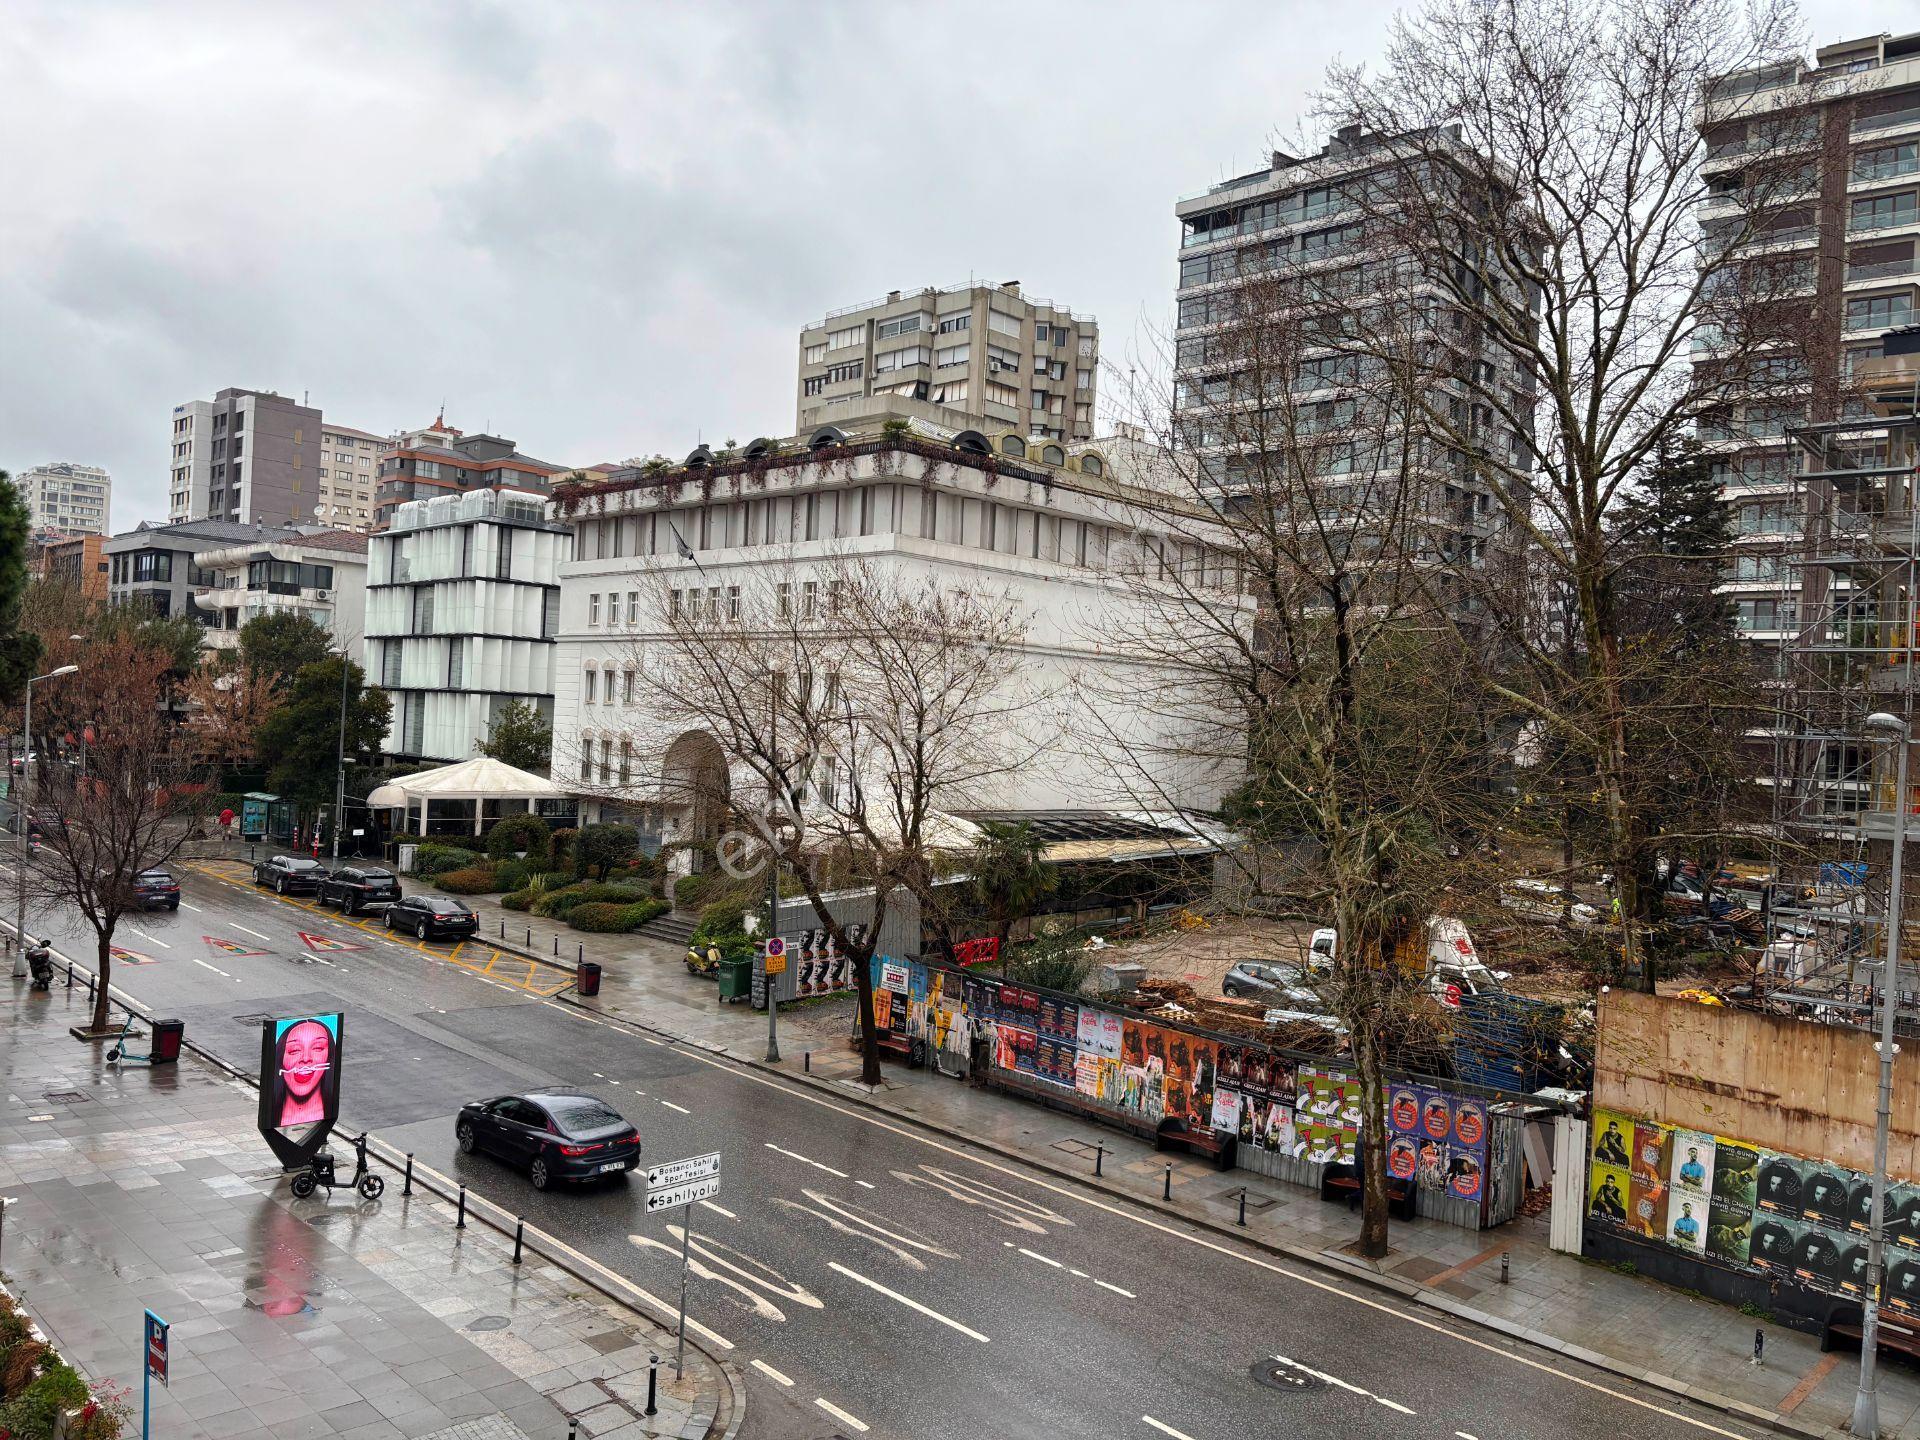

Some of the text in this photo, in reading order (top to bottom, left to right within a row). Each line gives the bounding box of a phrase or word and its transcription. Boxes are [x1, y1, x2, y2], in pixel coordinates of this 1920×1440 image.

[693, 1158, 712, 1168] Sahil
[665, 1168, 706, 1184] Spor Tesisi
[658, 1184, 718, 1206] Sahilyolu
